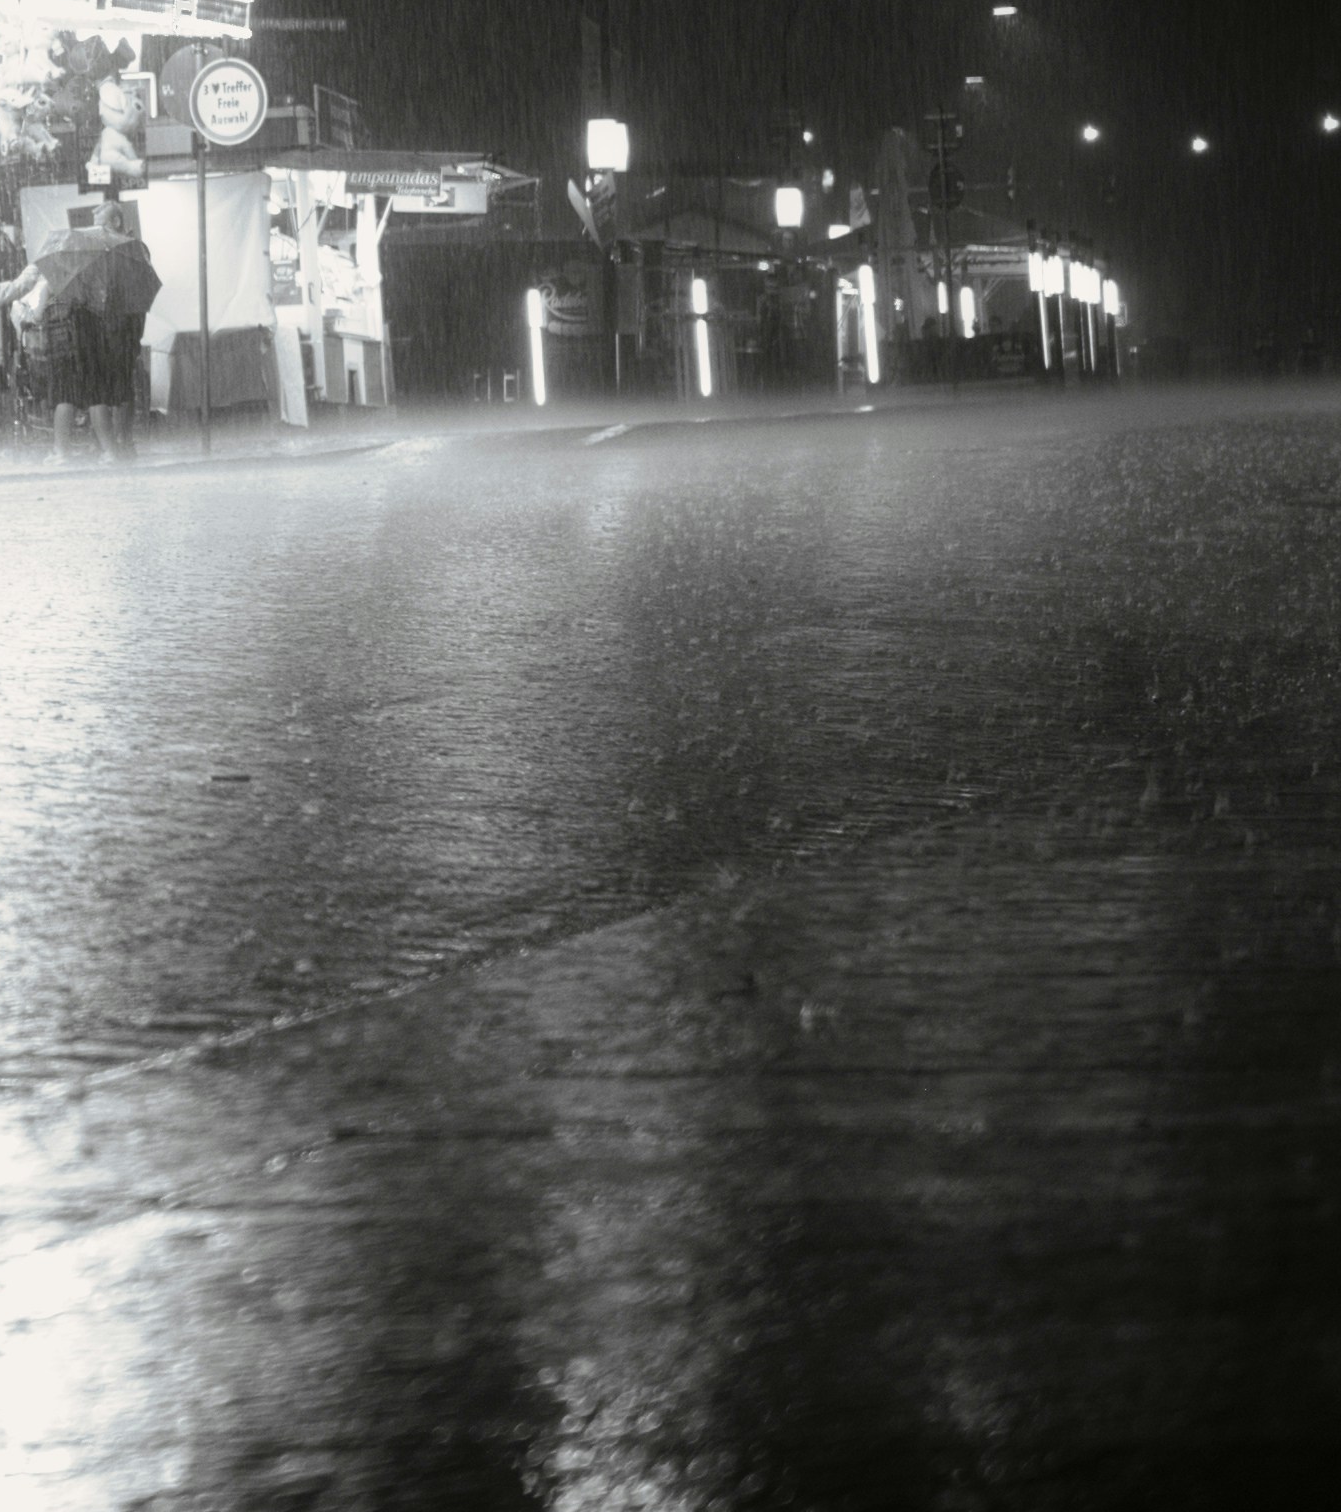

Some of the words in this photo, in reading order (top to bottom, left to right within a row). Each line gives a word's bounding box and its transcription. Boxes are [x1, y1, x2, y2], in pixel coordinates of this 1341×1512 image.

[203, 84, 209, 96] 3
[222, 80, 252, 94] Treffer
[217, 97, 239, 109] Freie
[211, 110, 248, 126] Auswahl
